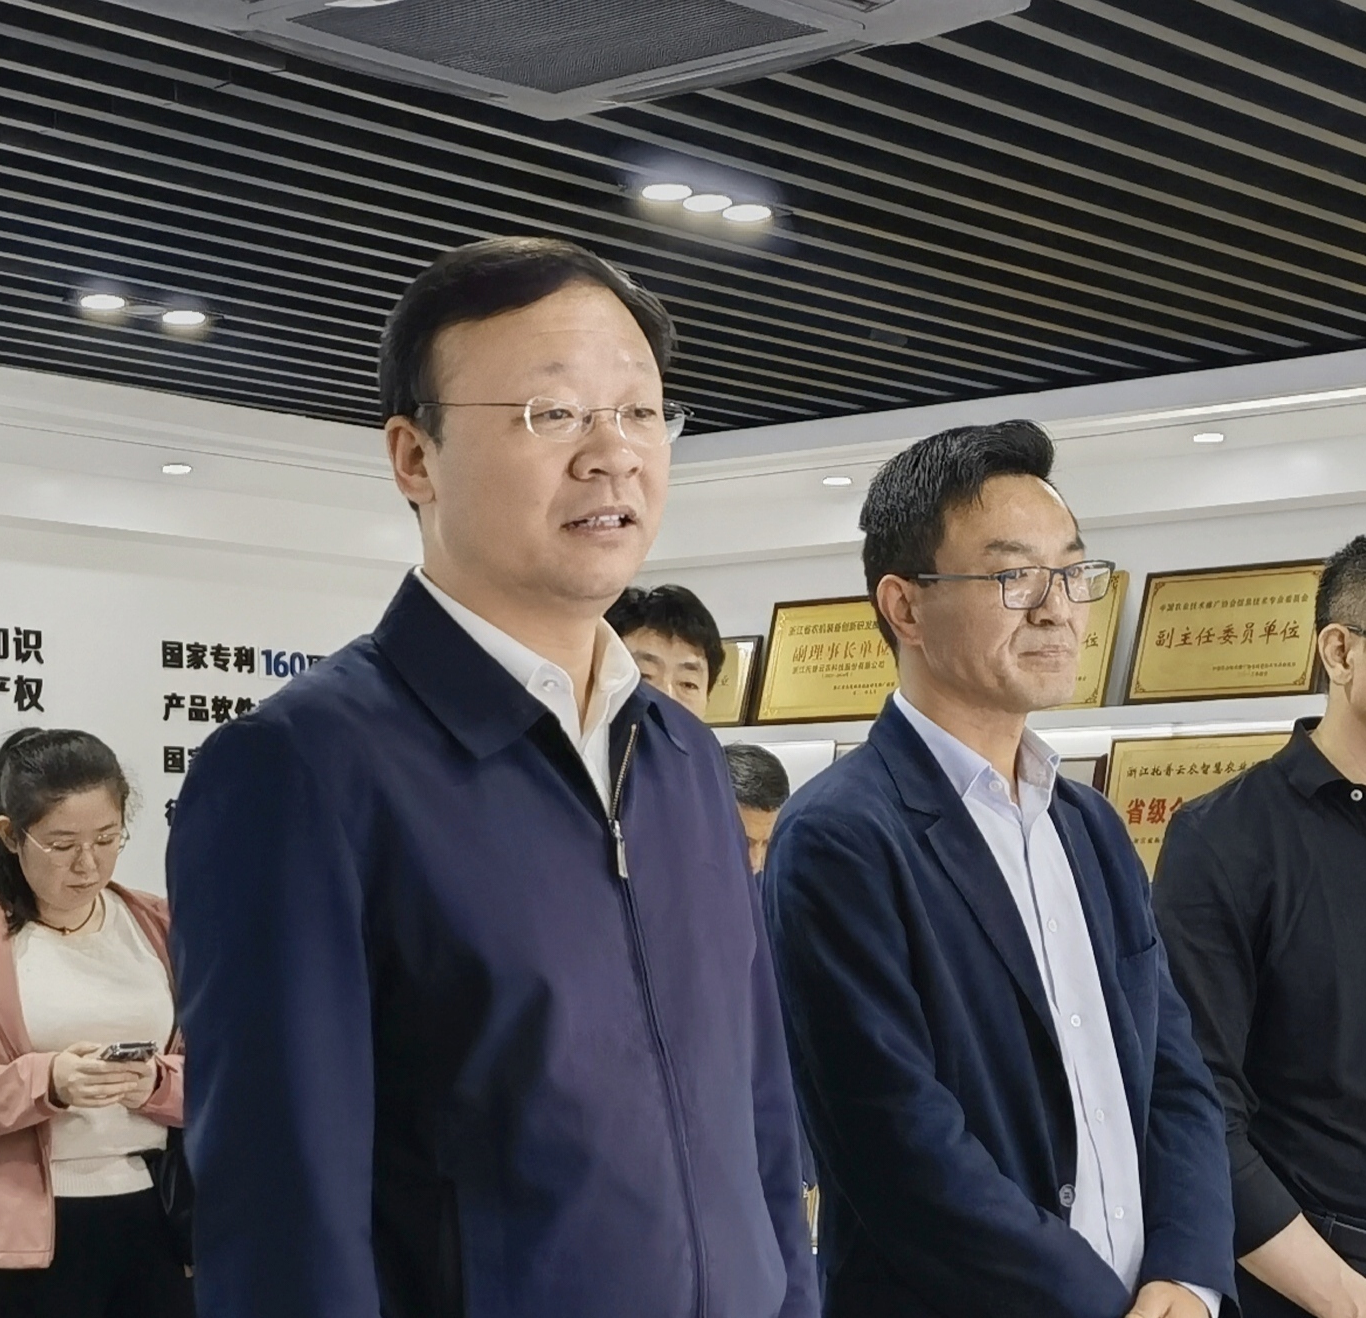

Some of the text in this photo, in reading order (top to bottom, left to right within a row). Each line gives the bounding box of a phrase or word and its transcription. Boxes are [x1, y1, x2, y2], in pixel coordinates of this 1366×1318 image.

[1155, 618, 1300, 650] 副主任委员单位
[1126, 760, 1261, 779] 浙江托普云农智慧农业
